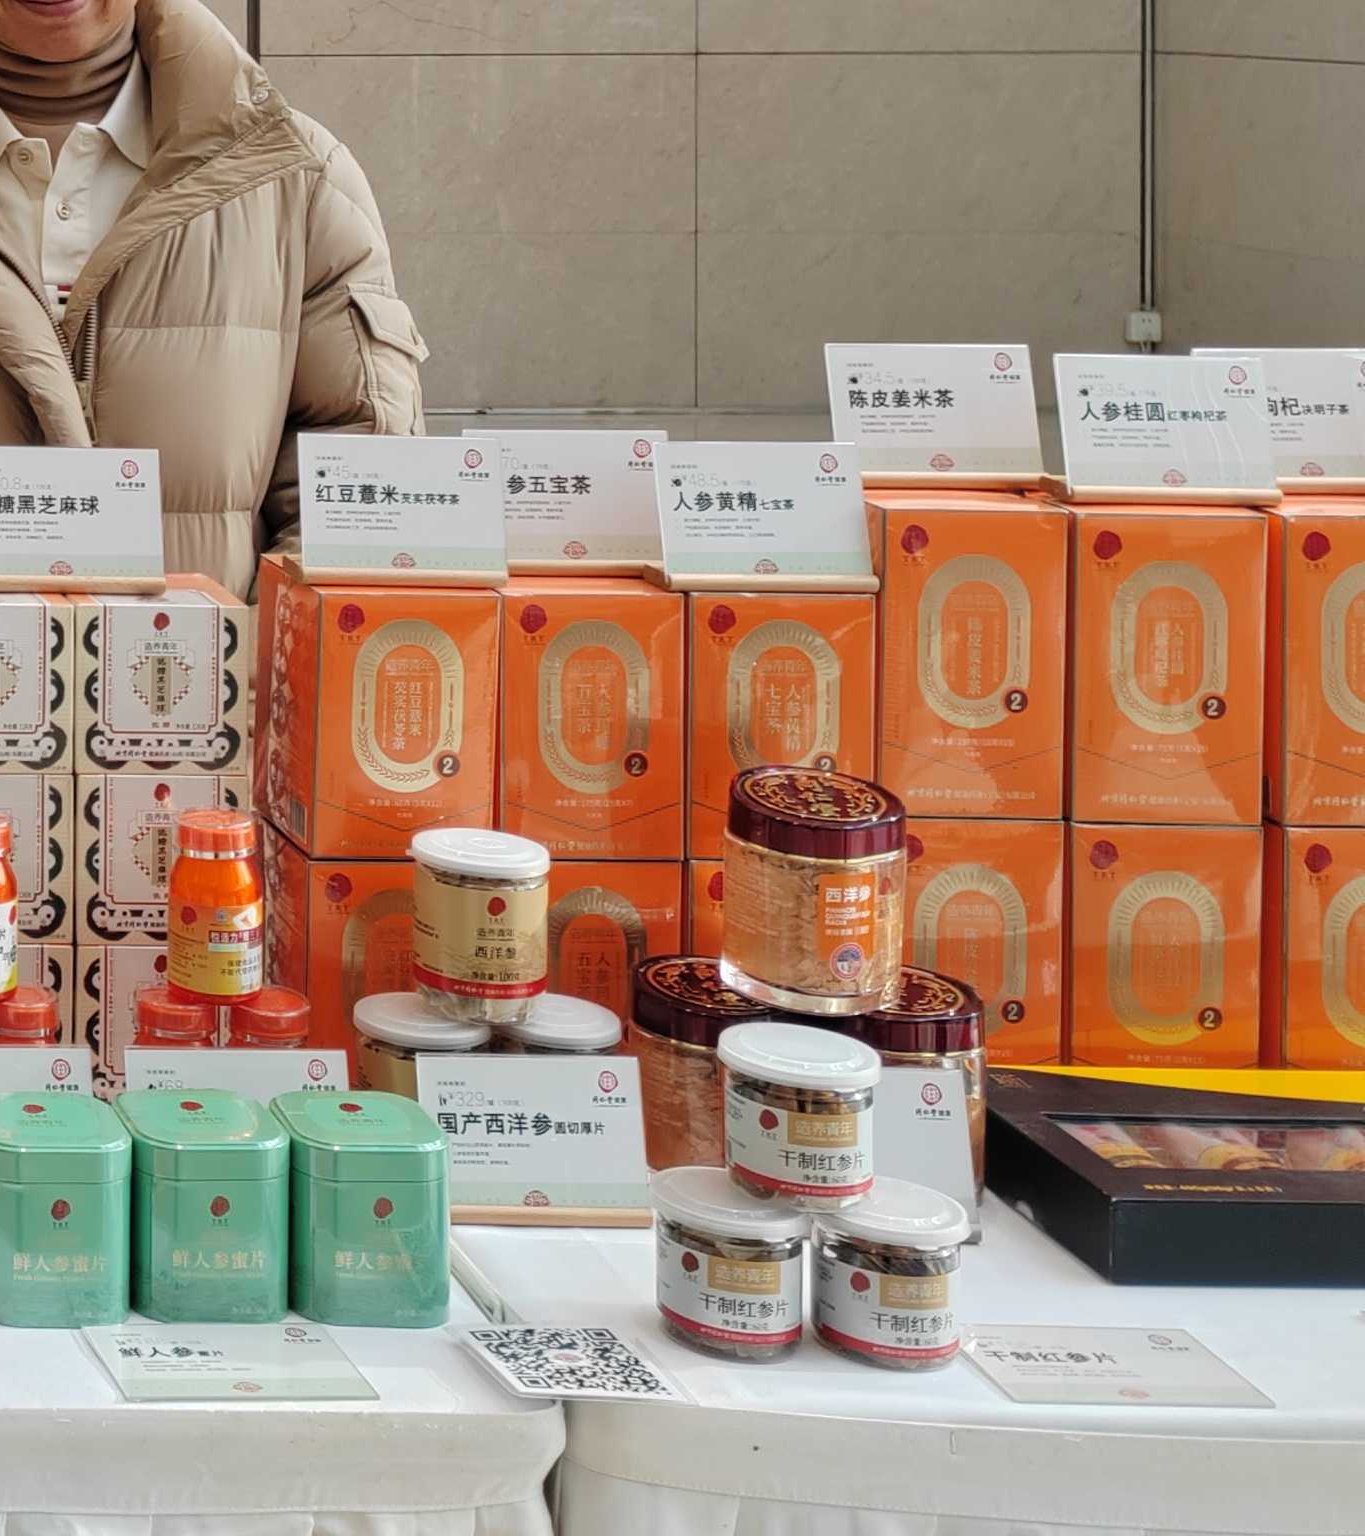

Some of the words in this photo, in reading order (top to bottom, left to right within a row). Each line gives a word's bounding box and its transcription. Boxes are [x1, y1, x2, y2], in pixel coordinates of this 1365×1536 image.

[847, 388, 955, 410] 陈皮姜米茶
[778, 1149, 867, 1172] 干制红参片
[12, 1252, 109, 1272] 鲜人参蜜片
[172, 1250, 267, 1270] 鲜人参蜜片
[699, 1292, 790, 1319] 干制红参片
[869, 1312, 954, 1335] 干制红参片
